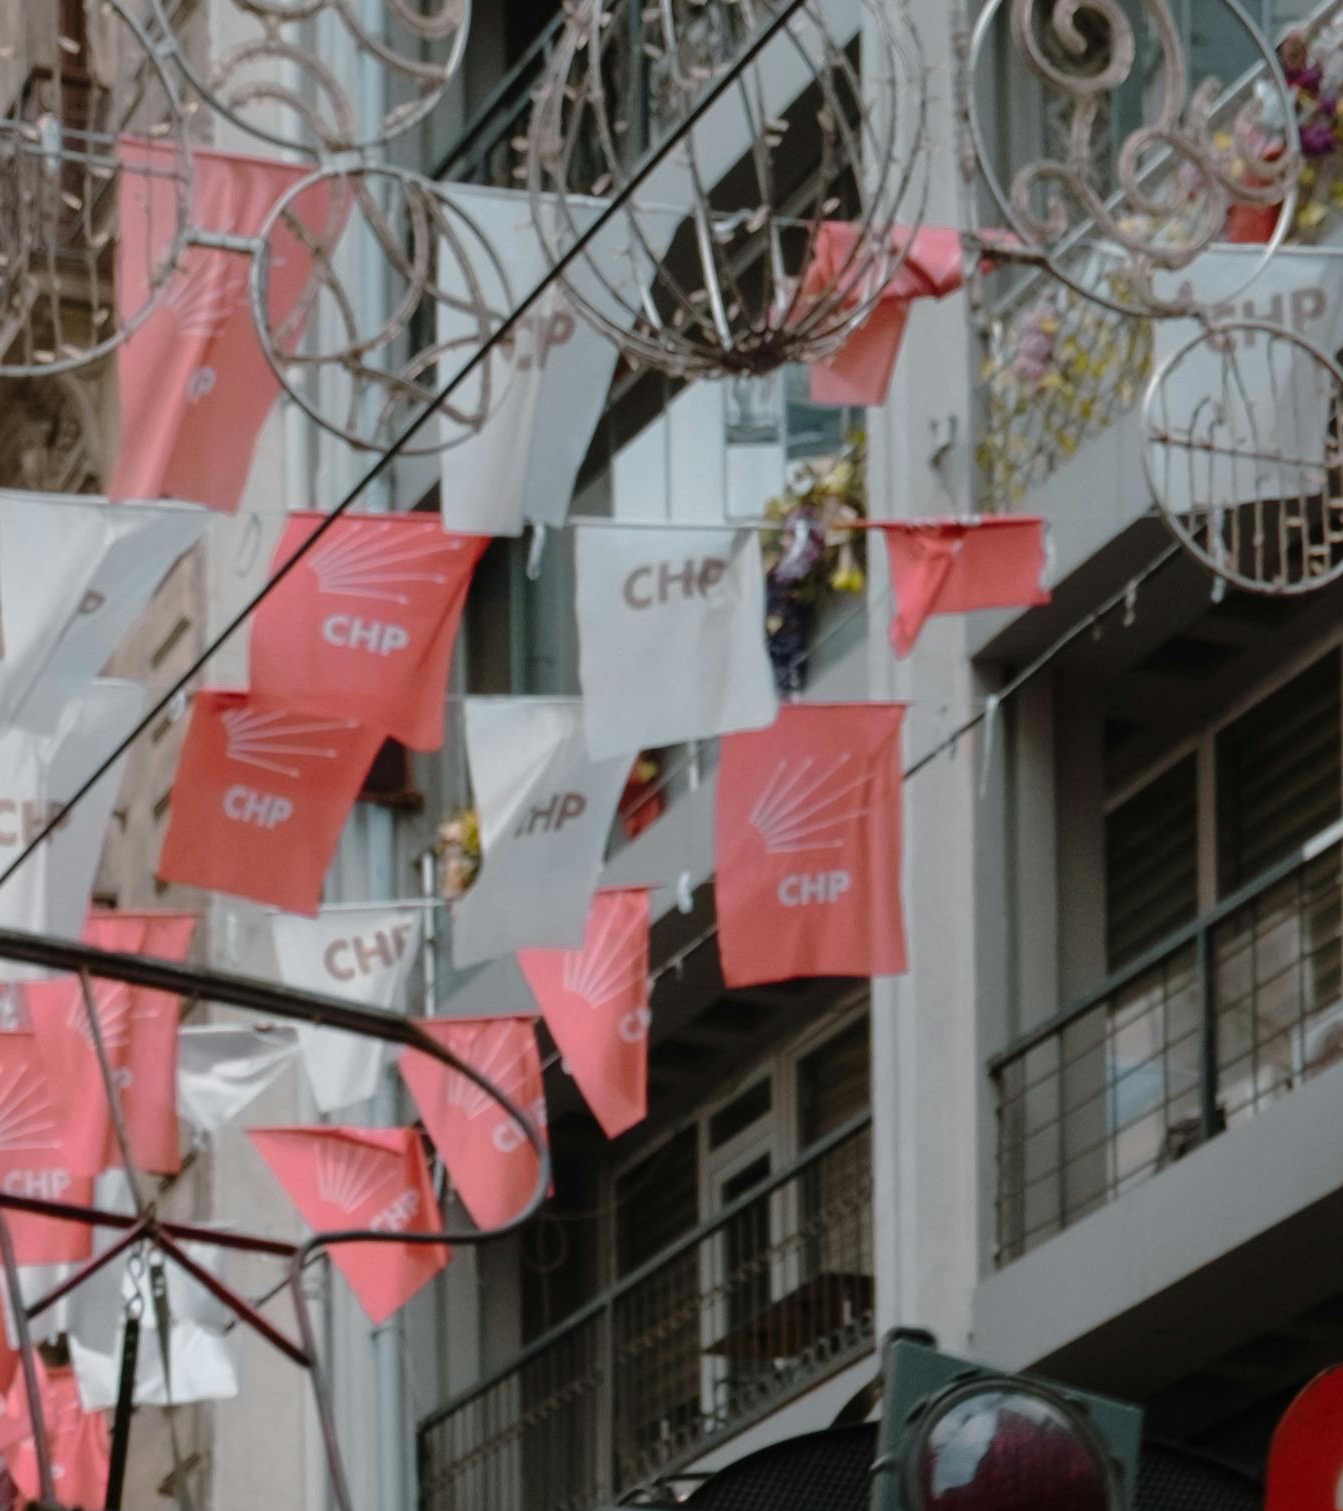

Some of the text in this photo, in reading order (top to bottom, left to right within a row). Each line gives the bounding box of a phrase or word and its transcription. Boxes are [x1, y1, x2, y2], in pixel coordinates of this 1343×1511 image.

[322, 613, 410, 656] CHP
[223, 784, 293, 830] CHP
[515, 793, 586, 838] HP
[778, 870, 851, 906] CHP
[4, 1168, 73, 1201] CHP
